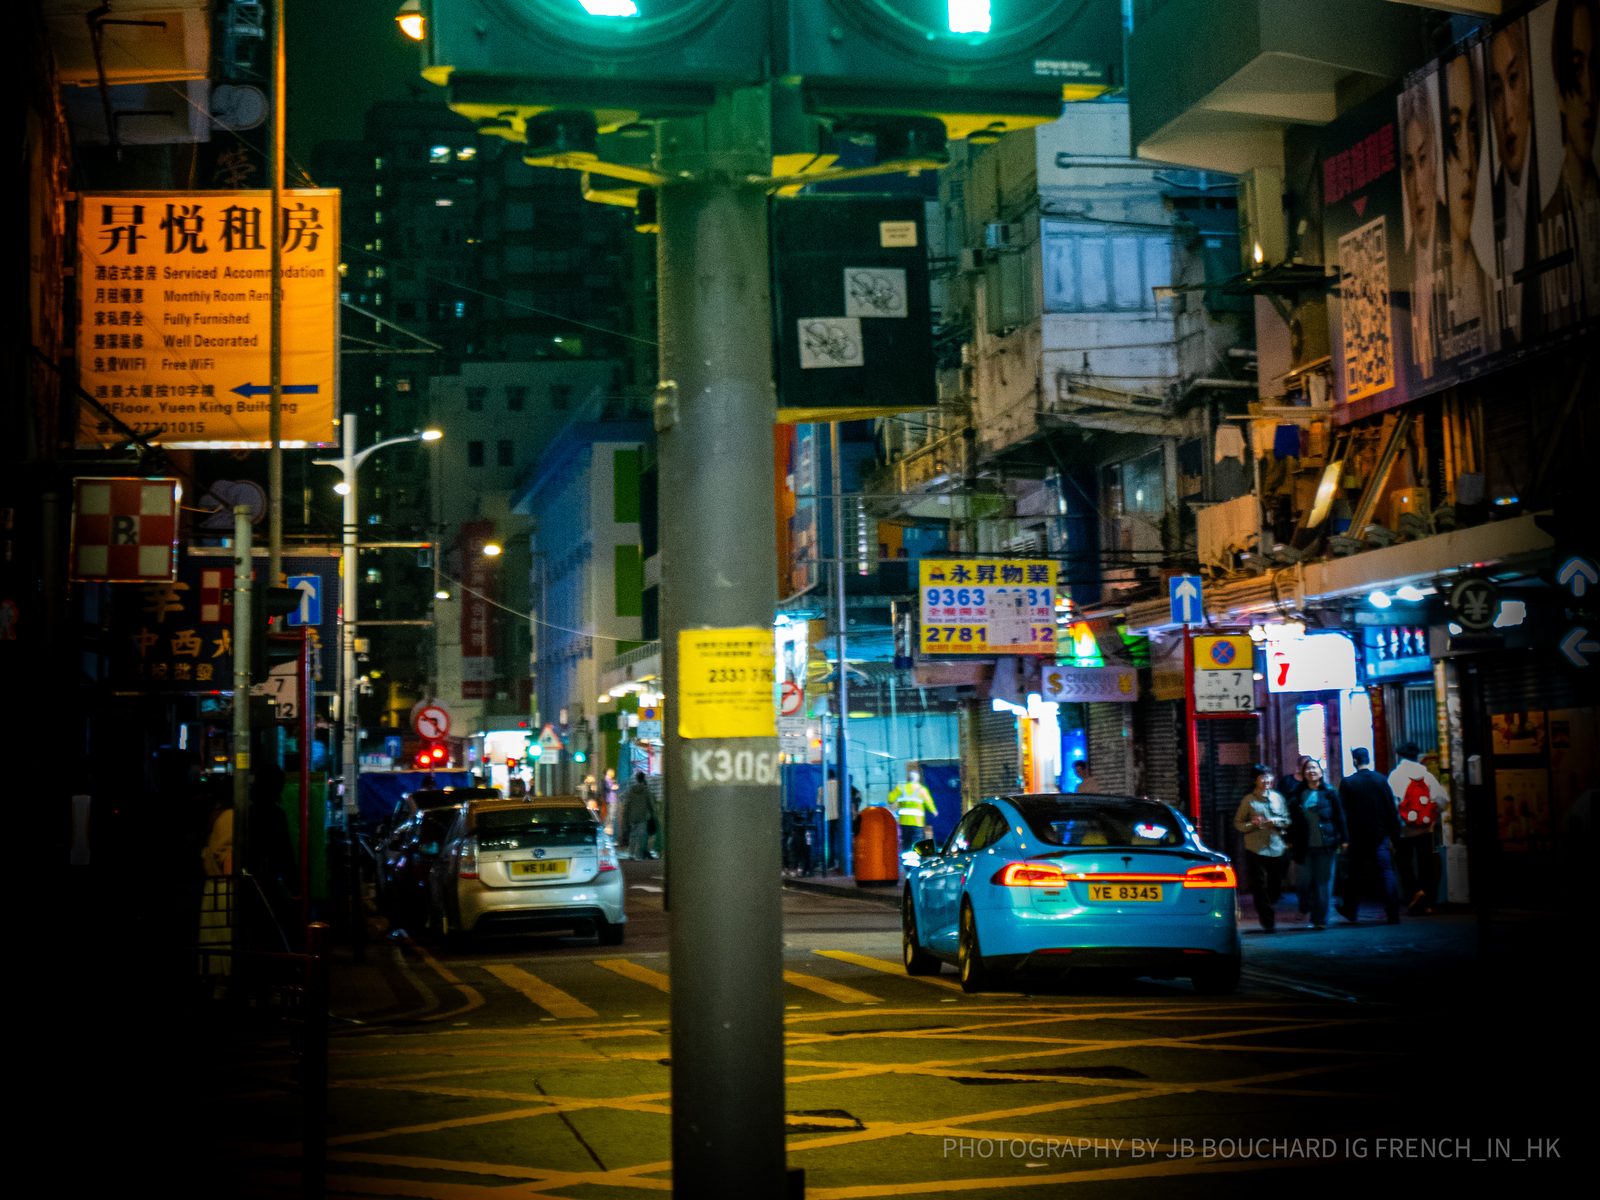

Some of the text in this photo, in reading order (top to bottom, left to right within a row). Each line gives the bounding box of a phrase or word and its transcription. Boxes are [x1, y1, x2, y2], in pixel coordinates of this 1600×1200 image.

[164, 266, 217, 279] Serviced
[164, 290, 210, 303] Monthly
[214, 290, 246, 301] Room
[164, 313, 250, 326] Fully Furnished
[164, 334, 258, 347] Well Decorated
[162, 359, 187, 370] Free
[159, 401, 195, 413] Yuen
[200, 401, 232, 415] King
[951, 565, 1049, 583] 永昇物業
[927, 589, 985, 606] 9363
[927, 628, 987, 642] 2781
[275, 679, 285, 692] 7
[1232, 672, 1242, 686] 7
[1233, 695, 1251, 708] 12
[1093, 887, 1158, 899] YE 8345
